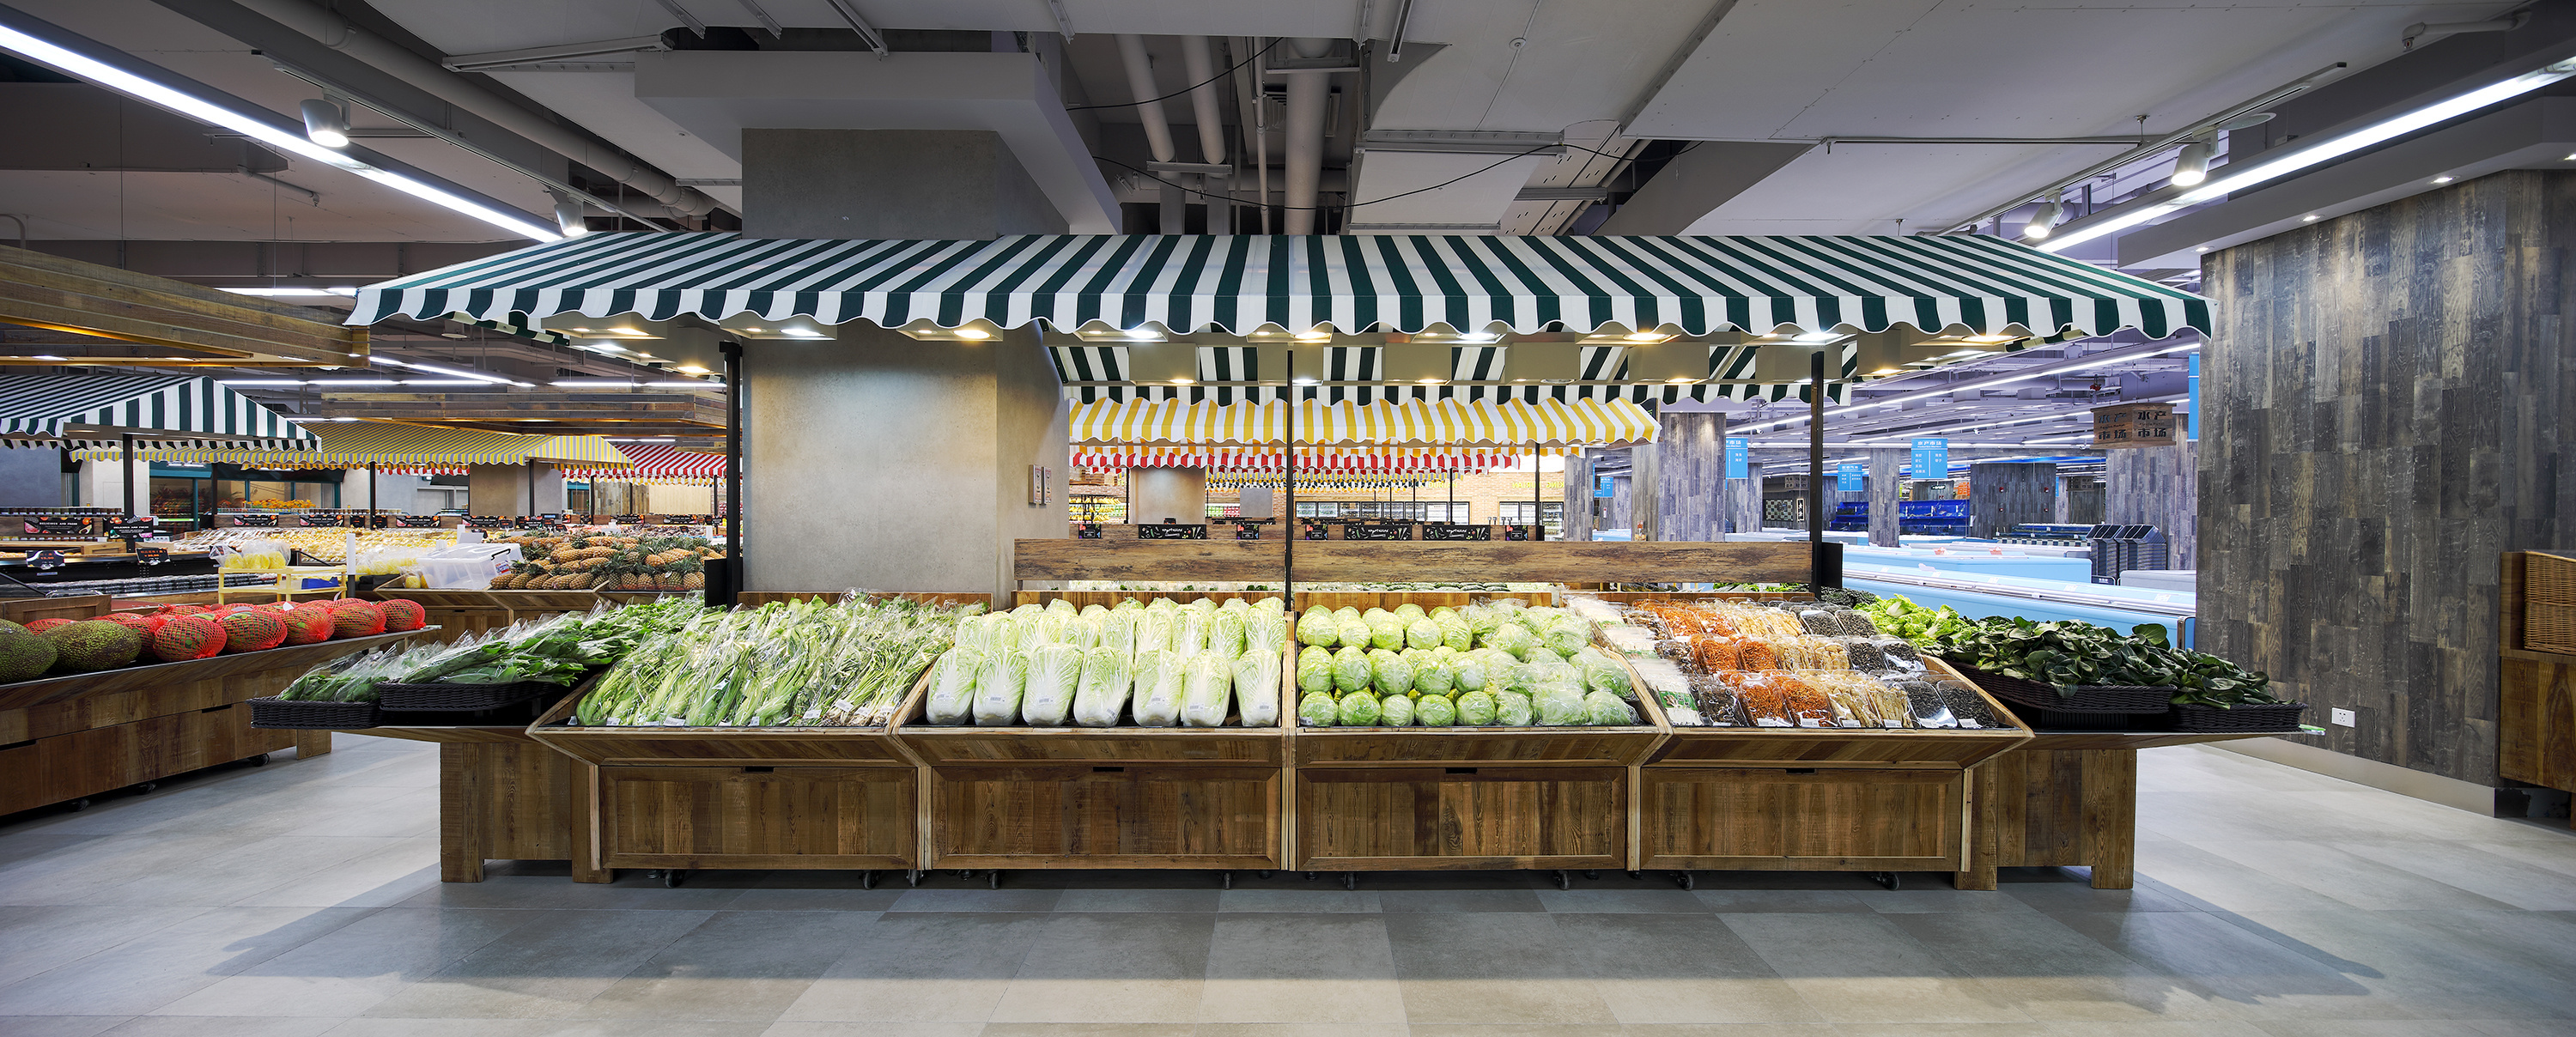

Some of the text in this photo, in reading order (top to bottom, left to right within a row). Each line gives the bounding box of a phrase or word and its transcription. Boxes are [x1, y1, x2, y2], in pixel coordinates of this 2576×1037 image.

[2099, 412, 2127, 423] 水产
[2137, 410, 2166, 421] 水产
[2098, 429, 2127, 440] 市场
[2137, 428, 2166, 438] 市场
